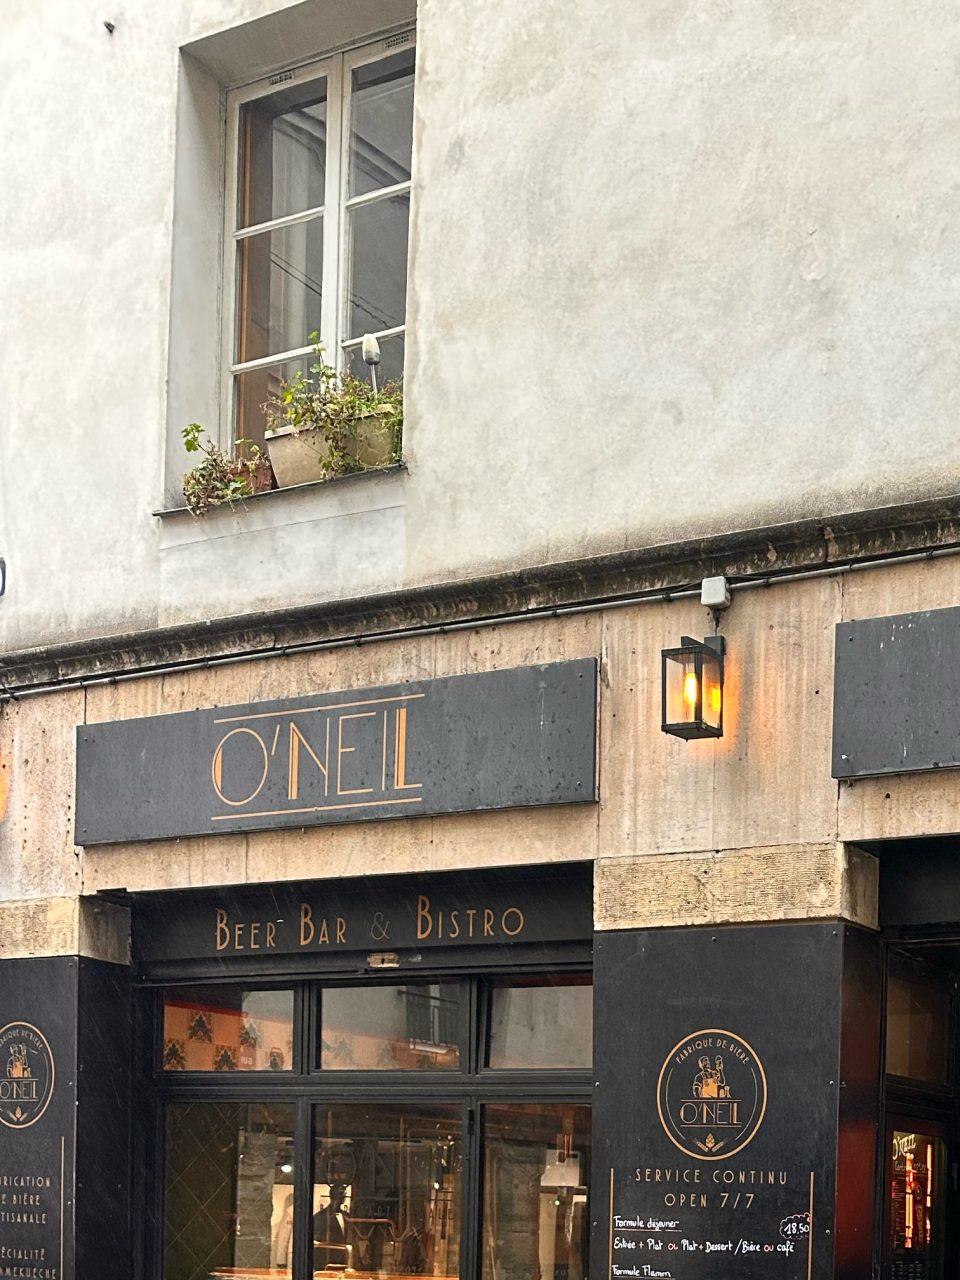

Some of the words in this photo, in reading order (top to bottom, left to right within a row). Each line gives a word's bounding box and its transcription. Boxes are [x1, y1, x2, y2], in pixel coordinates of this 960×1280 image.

[211, 707, 423, 806] O'NEIL
[370, 912, 390, 940] &
[417, 895, 524, 940] BISTRO
[675, 1038, 713, 1064] FABRIQUE
[717, 1039, 727, 1049] DE
[680, 1102, 742, 1125] O'NEIL
[635, 1169, 701, 1183] SERVICE
[713, 1170, 788, 1185] CONTINU
[664, 1193, 707, 1208] OPEN
[720, 1193, 755, 1208] 7/7
[613, 1215, 644, 1228] Formule
[613, 1236, 636, 1249] Entrée
[646, 1238, 664, 1251] Plat
[680, 1239, 698, 1251] Plat
[611, 1265, 640, 1276] Formule
[642, 1264, 672, 1278] Flamm
